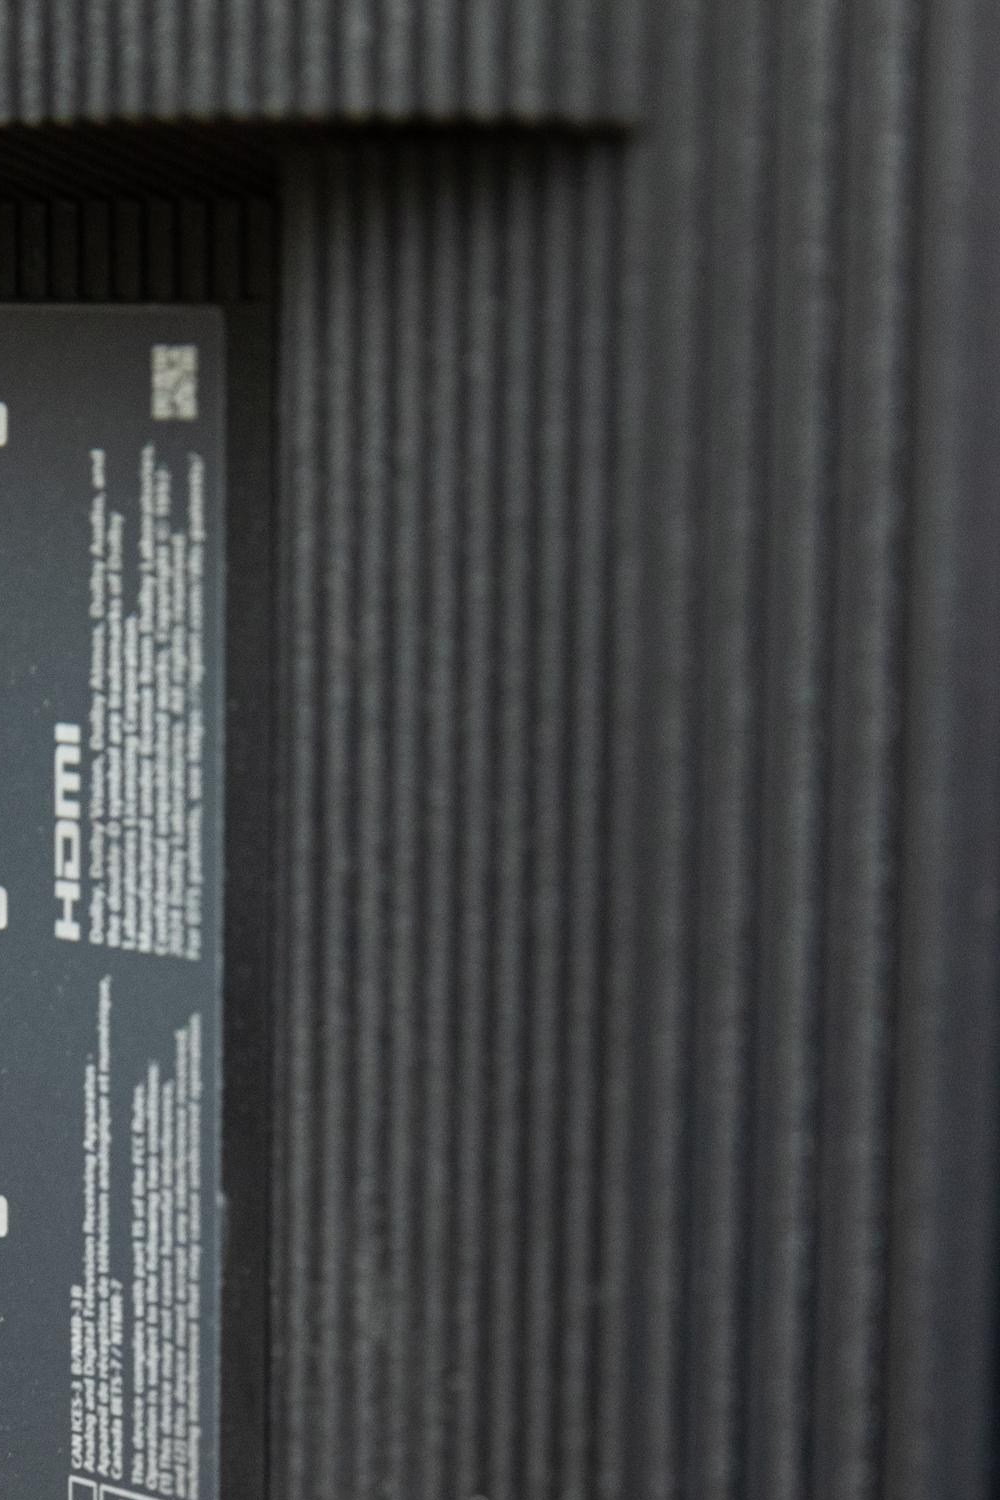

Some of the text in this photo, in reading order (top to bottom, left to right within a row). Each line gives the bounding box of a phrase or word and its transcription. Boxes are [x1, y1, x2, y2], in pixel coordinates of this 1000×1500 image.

[55, 723, 81, 941] HDMI
[82, 1154, 96, 1234] Receiving
[83, 1236, 95, 1318] Television
[132, 1241, 145, 1278] part
[98, 1276, 109, 1299] de
[132, 1280, 144, 1317] with
[83, 1321, 97, 1376] Digital
[132, 1321, 145, 1394] complies
[71, 1381, 83, 1432] ICES-3
[83, 1378, 95, 1411] and
[98, 1381, 109, 1403] de
[83, 1413, 97, 1473] Analog
[97, 1405, 111, 1477] Appareil
[110, 1418, 123, 1480] Canada
[132, 1396, 144, 1450] device
[70, 1434, 83, 1469] CAN
[132, 1453, 144, 1484] This
